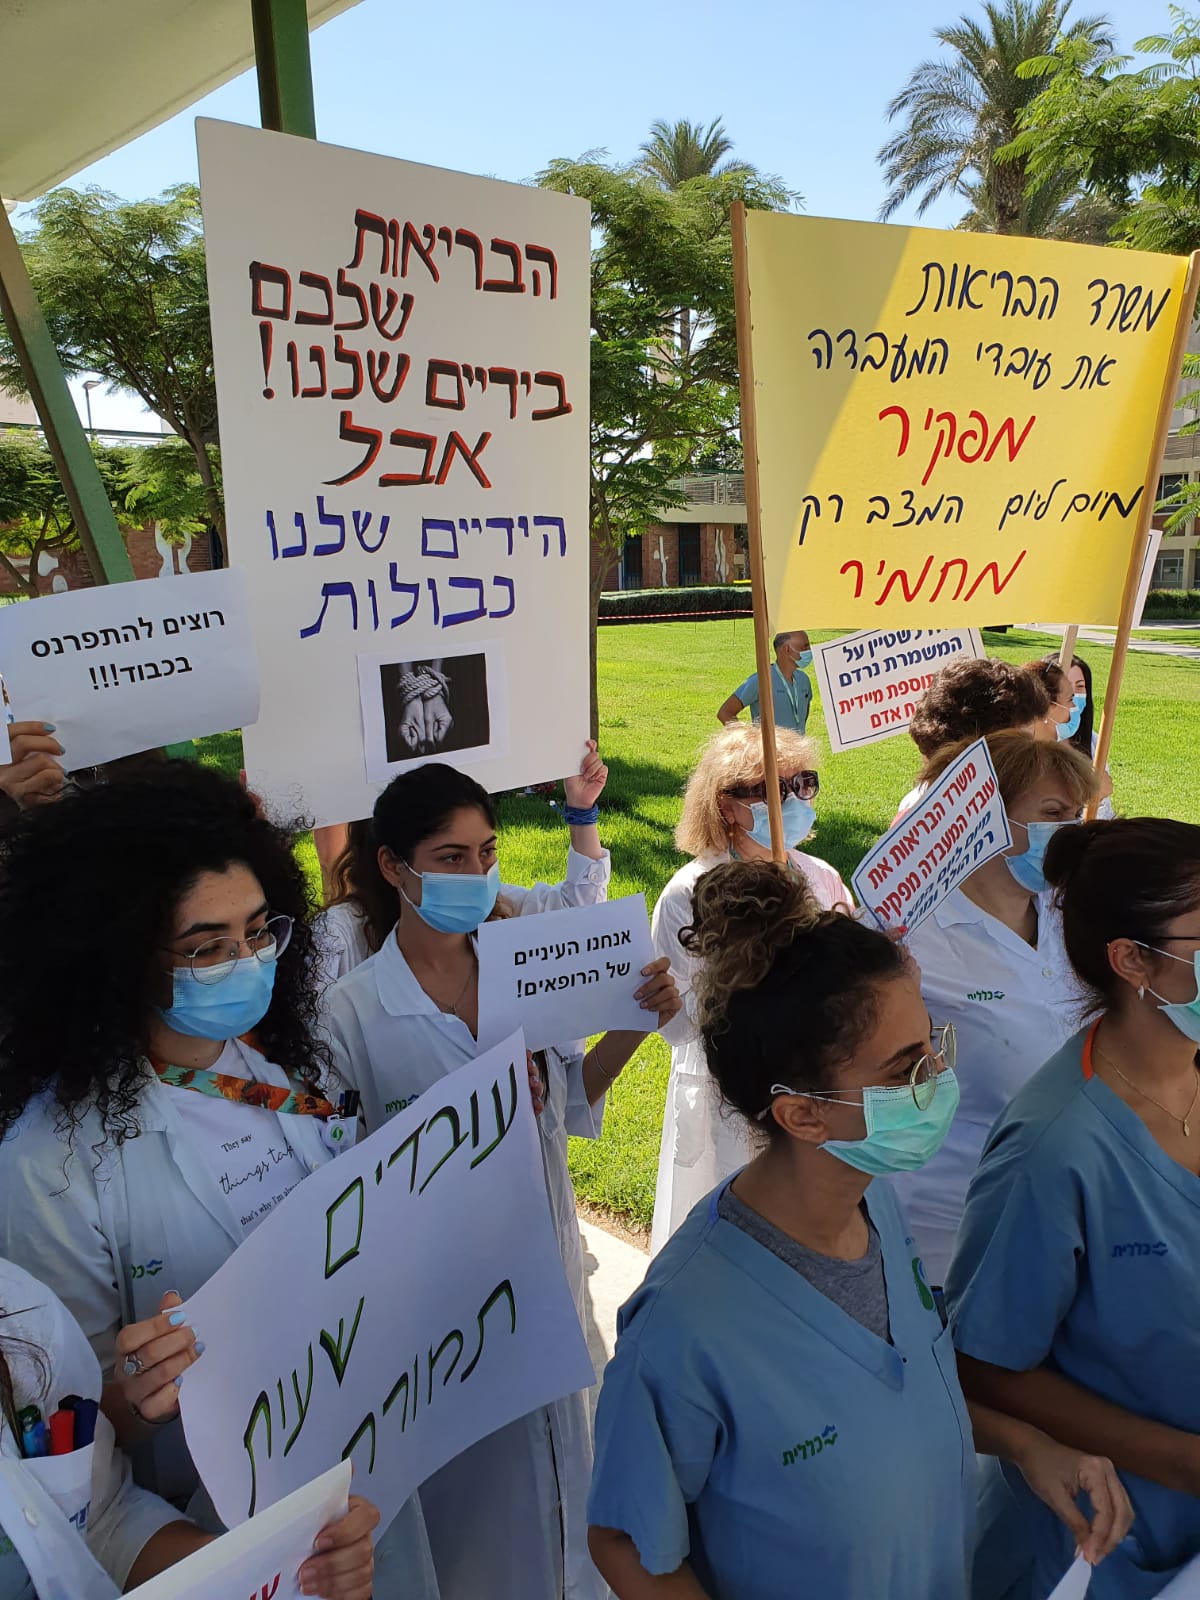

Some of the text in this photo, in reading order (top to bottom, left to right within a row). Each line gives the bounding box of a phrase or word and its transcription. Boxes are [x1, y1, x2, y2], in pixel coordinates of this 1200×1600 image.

[345, 209, 558, 299] הבריאות
[249, 260, 415, 341] שלכם
[905, 261, 1171, 334] משרד הבריאות
[259, 321, 573, 421] בידיים שלנו!
[807, 328, 1118, 391] את עובדי המעבדה
[322, 411, 492, 489] אבל
[878, 405, 1037, 486] מפקיר
[266, 496, 567, 560] הידיים שלנו
[799, 478, 1145, 546] מיום ליום המצב רק
[300, 562, 515, 639] כבולות
[839, 549, 1027, 606] מחמיר
[31, 609, 226, 658] רוצים להתפרנס
[838, 636, 963, 687] המשמרת נרדם
[842, 643, 865, 663] על
[89, 656, 193, 690] בכבוד!!!
[838, 688, 883, 715] מיידית
[870, 706, 902, 728] אדם
[867, 762, 977, 890] משרד הבריאות את
[874, 776, 995, 921] עובדי המעבדה מפקיר
[973, 830, 994, 860] רק
[514, 929, 632, 966] אנחנו העיניים
[516, 961, 631, 998] של הרופאים!
[221, 1133, 252, 1153] They say
[325, 1061, 518, 1280] עובדים
[219, 1160, 270, 1195] things
[259, 1201, 272, 1213] why
[243, 1296, 365, 1519] שעות
